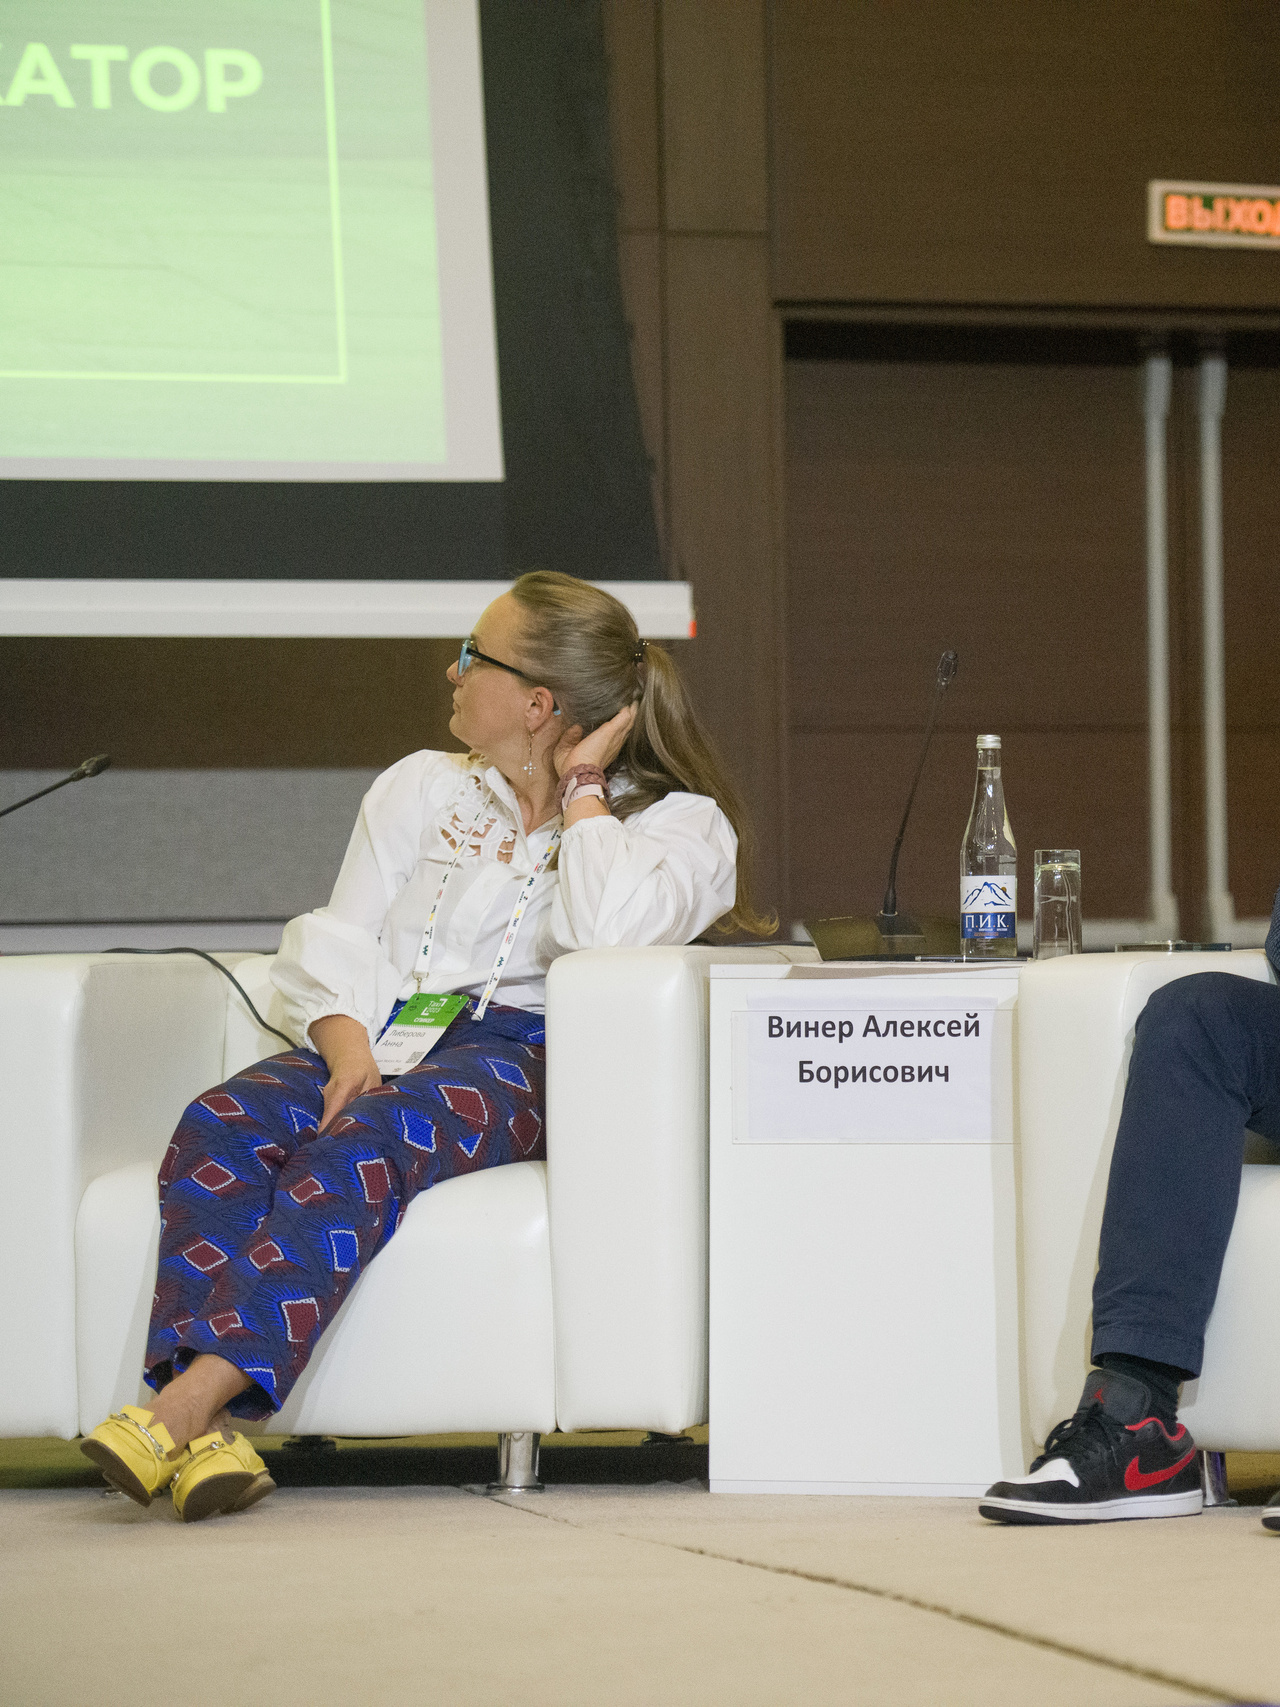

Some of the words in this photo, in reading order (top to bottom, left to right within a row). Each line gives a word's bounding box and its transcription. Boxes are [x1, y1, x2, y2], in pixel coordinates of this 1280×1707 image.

[0, 42, 264, 114] АТОР
[389, 1029, 426, 1039] Либерова
[768, 1015, 854, 1043] Винер
[862, 1013, 980, 1038] Алексей
[381, 1040, 404, 1048] Анна
[798, 1060, 950, 1089] Борисович
